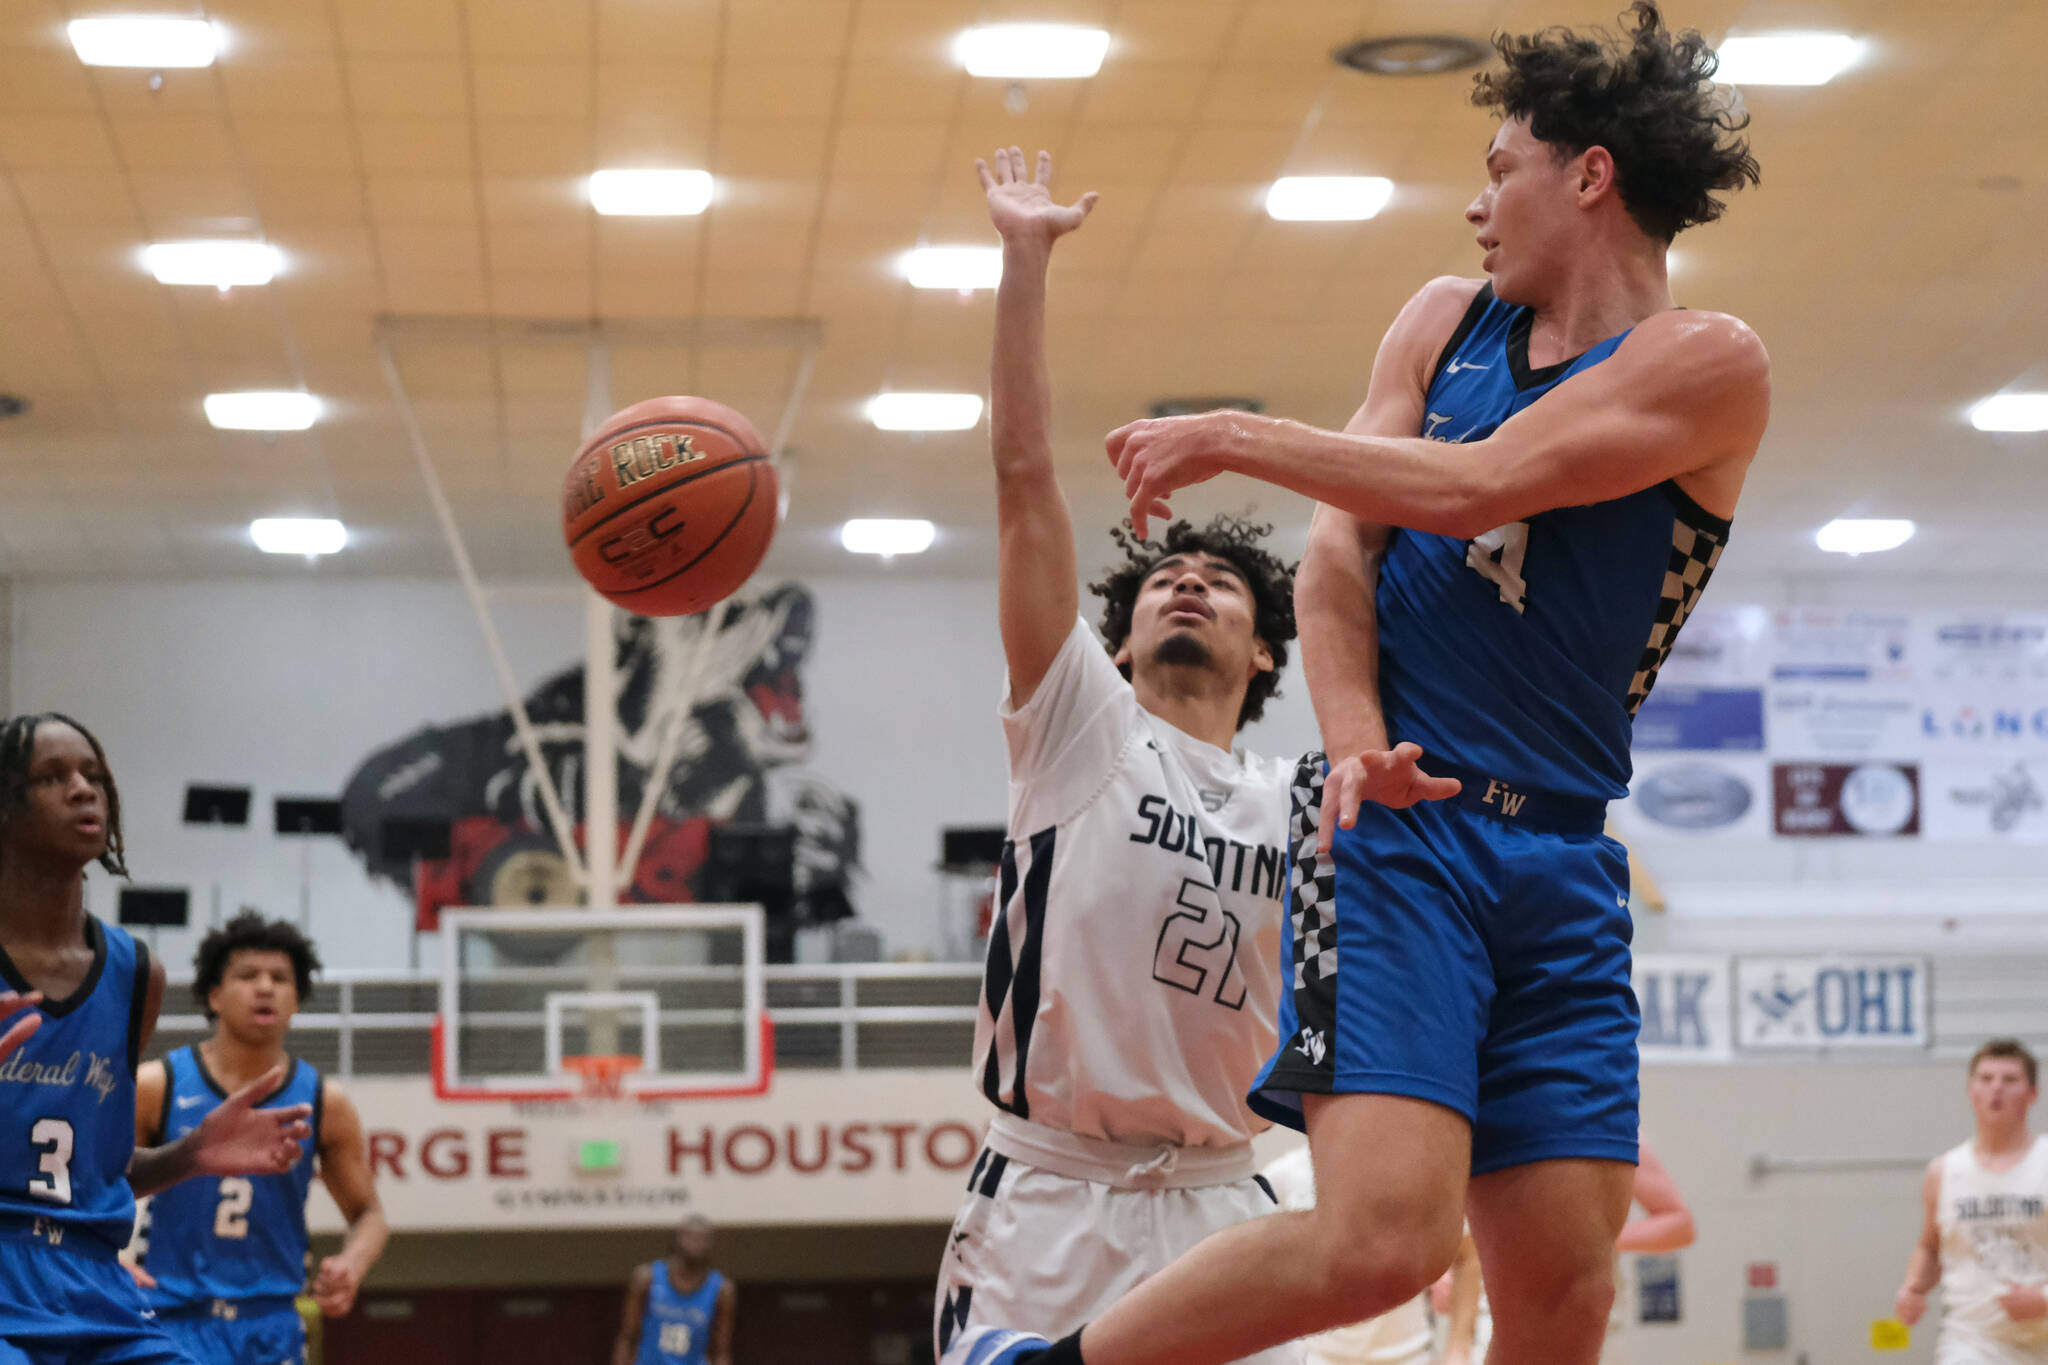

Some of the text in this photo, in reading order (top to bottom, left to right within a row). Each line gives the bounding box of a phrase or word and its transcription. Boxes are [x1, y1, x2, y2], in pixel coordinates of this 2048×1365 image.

[1482, 778, 1526, 816] FW
[1815, 966, 1916, 1037] OHI
[29, 1118, 74, 1204] 3
[369, 1121, 977, 1179] RGE HOUSTO
[213, 1176, 253, 1239] 2
